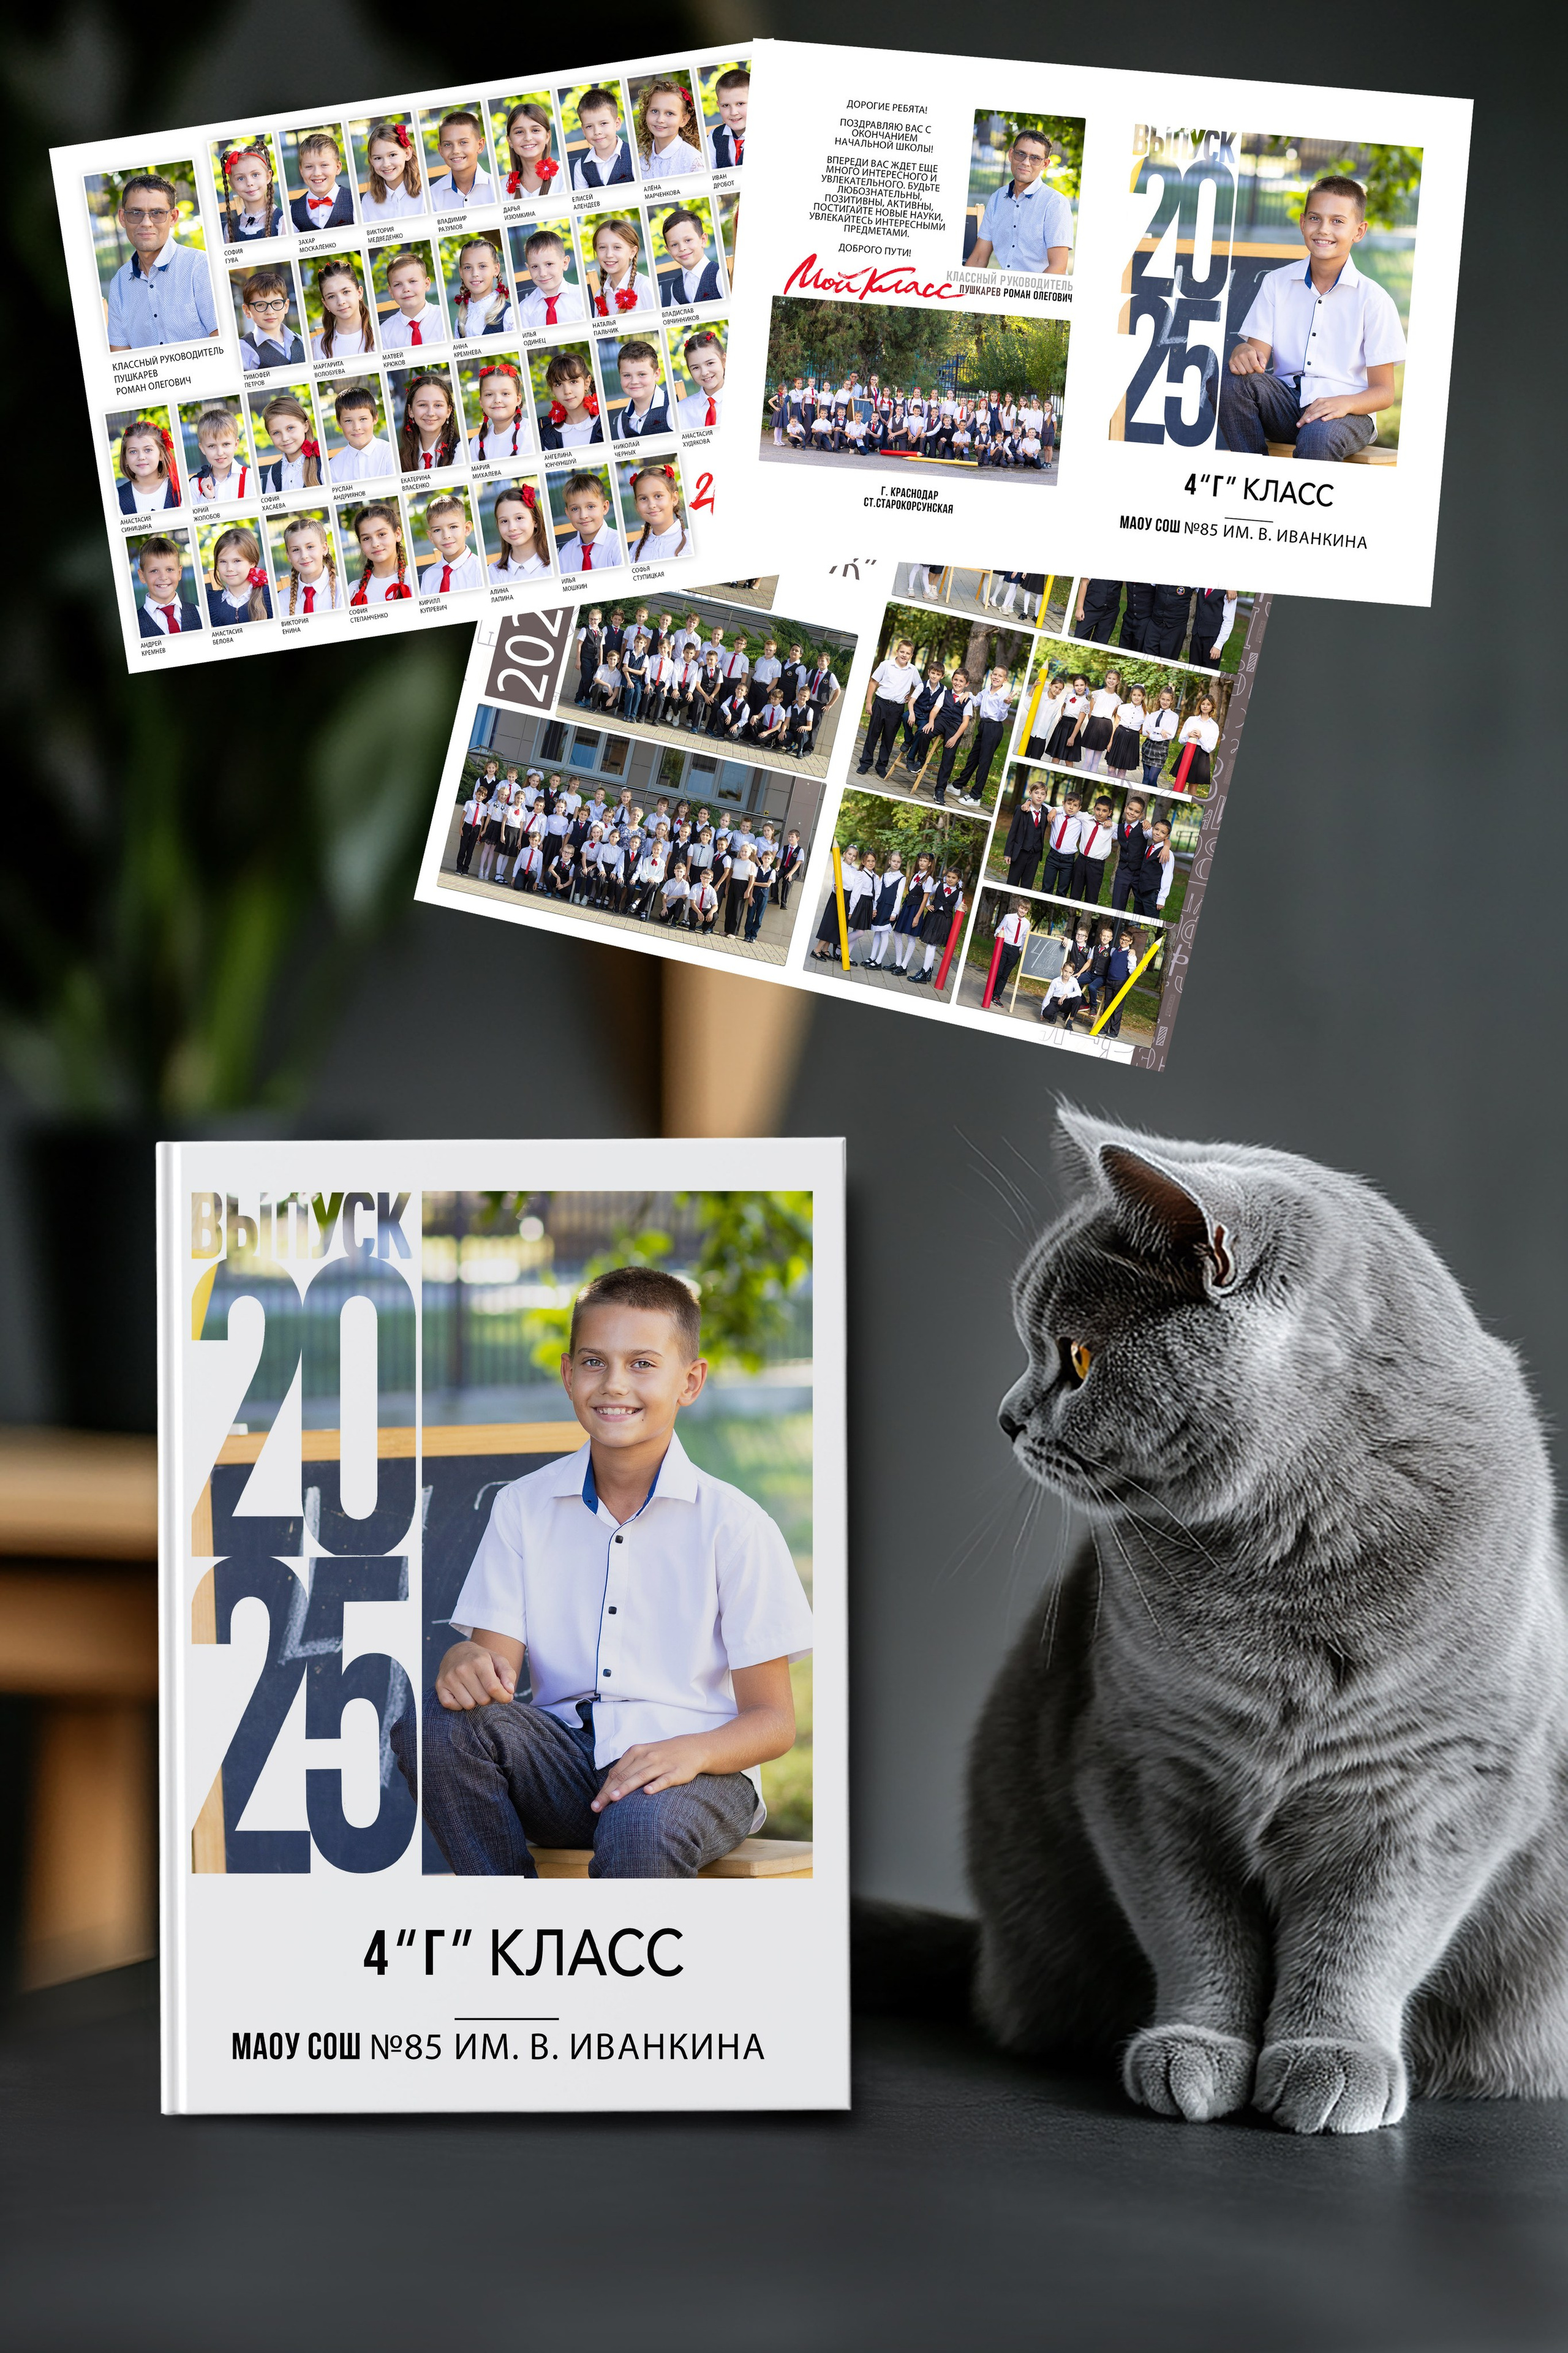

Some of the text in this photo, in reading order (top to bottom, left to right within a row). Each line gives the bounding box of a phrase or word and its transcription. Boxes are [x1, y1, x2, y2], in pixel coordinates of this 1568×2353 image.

[846, 99, 927, 114] ДОРОГИЕ РЕБЯТА!
[840, 118, 932, 134] ПОЗДРАВЛЯЮ ВАС С
[851, 129, 918, 142] ОКОНЧАНИЕМ
[835, 137, 933, 153] НАЧАЛЬНОЙ ШКОЛЫ!
[1133, 123, 1238, 164] ВЫПУСК
[827, 156, 938, 174] ВПЕРЕДИ ВАС ЖДЕТ ЕЩЕ
[826, 165, 860, 176] МНОГО
[862, 168, 928, 181] ИНТЕРЕСНОГО
[713, 180, 734, 189] ДРОБОТ
[821, 174, 940, 192] УВЛЕКАТЕЛЬНОГО. БУДЬТЕ
[644, 189, 680, 200] МАРЧЕНКОВА
[837, 185, 922, 201] ЛЮБОЗНАТЕЛЬНЫ,
[571, 194, 594, 203] ЕЛИСЕЙ
[824, 194, 933, 211] ПОЗИТИВНЫ, АКТИВНЫ,
[503, 205, 521, 214] ДАРЬЯ
[573, 201, 600, 210] АЛЕНДЕЕВ
[504, 211, 536, 221] ИЗЮМКИНА
[813, 202, 943, 222] ПОСТИГАЙТЕ НОВЫЕ НАУКИ,
[437, 215, 467, 225] ВЛАДИМИР
[809, 211, 946, 231] УВЛЕКАЙТЕСЬ ИНТЕРЕСНЫМИ
[366, 226, 394, 236] ВИКТОРИЯ
[438, 224, 463, 232] РАЗУМОВ
[844, 224, 910, 238] ПРЕДМЕТАМИ.
[1121, 157, 1234, 300] 20
[368, 233, 403, 243] МЕДВЕДЕНКО
[300, 242, 337, 253] МОСКАЛЕНКО
[838, 243, 911, 257] ДОБРОГО ПУТИ!
[946, 271, 1073, 291] КЛАССНЫЙ РУКОВОДИТЕЛЬ
[959, 284, 1072, 303] ПУШКАРЕВ РОМАН ОЛЕГОВИЧ
[662, 308, 694, 318] ВЛАДИСЛАВ
[592, 320, 616, 328] НАТАЛЬЯ
[663, 314, 699, 325] ОВЧИННИКОВ
[594, 327, 619, 336] ПАЛЬЧИК
[523, 338, 546, 346] ОДИНЕЦ
[112, 346, 224, 371] КЛАССНЫЙ РУКОВОДИТЕЛЬ
[382, 352, 404, 360] МАТВЕЙ
[453, 349, 482, 358] КРЕМНЕВА
[313, 360, 344, 370] МАРГАРИТА
[114, 369, 158, 383] ПУШКАРЕВ
[243, 371, 270, 380] ТИМОФЕЙ
[314, 368, 345, 378] ВОЛОБУЕВА
[1109, 295, 1223, 447] 25
[116, 376, 191, 395] РОМАН ОЛЕГОВИЧ
[682, 429, 713, 440] АНАСТАСИЯ
[613, 440, 640, 450] НИКОЛАЙ
[682, 438, 710, 447] ХУДЯКОВА
[544, 451, 573, 461] АНГЕЛИНА
[545, 458, 577, 468] ЮНЧУНШУЙ
[401, 474, 431, 484] ЕКАТЕРИНА
[472, 470, 502, 480] МИХАЛЕВА
[331, 485, 353, 493] РУСЛАН
[402, 482, 430, 491] ВЛАСЕНКО
[333, 491, 366, 500] АНДРИЯНОВ
[881, 486, 939, 500] Г. КРАСНОДАР
[1243, 477, 1334, 507] КЛАСС
[262, 502, 286, 511] ХАСАЕВА
[864, 497, 953, 514] СТ.СТАРОКОРСУНСКАЯ
[120, 515, 151, 526] АНАСТАСИЯ
[193, 513, 221, 522] ЖОЛОБОВ
[121, 523, 153, 533] СИНИЦЫНА
[1120, 515, 1367, 550] МАОУ СОШ №85 ИМ. В. ИВАНКИНА
[633, 571, 665, 581] СТУПИЦКАЯ
[562, 583, 587, 592] МОШКИН
[418, 597, 440, 606] КИРИЛЛ
[491, 594, 514, 603] ЛАПИНА
[349, 607, 368, 616] СОФИЯ
[420, 604, 447, 614] КУПРЕВИЧ
[281, 618, 309, 627] ВИКТОРИЯ
[350, 612, 388, 624] СТЕПАНЧЕНКО
[211, 627, 243, 638] АНАСТАСИЯ
[140, 640, 162, 648] АНДРЕЙ
[141, 648, 166, 656] КРЕМНЕВ
[191, 1192, 413, 1259] ВЫПУСК
[192, 1255, 417, 1556] 20
[192, 1556, 418, 1873] 25
[492, 1928, 684, 1976] КЛАСС
[233, 2033, 764, 2060] МАОУ СОШ №85 ИМ. В. ИВАНКИНА
